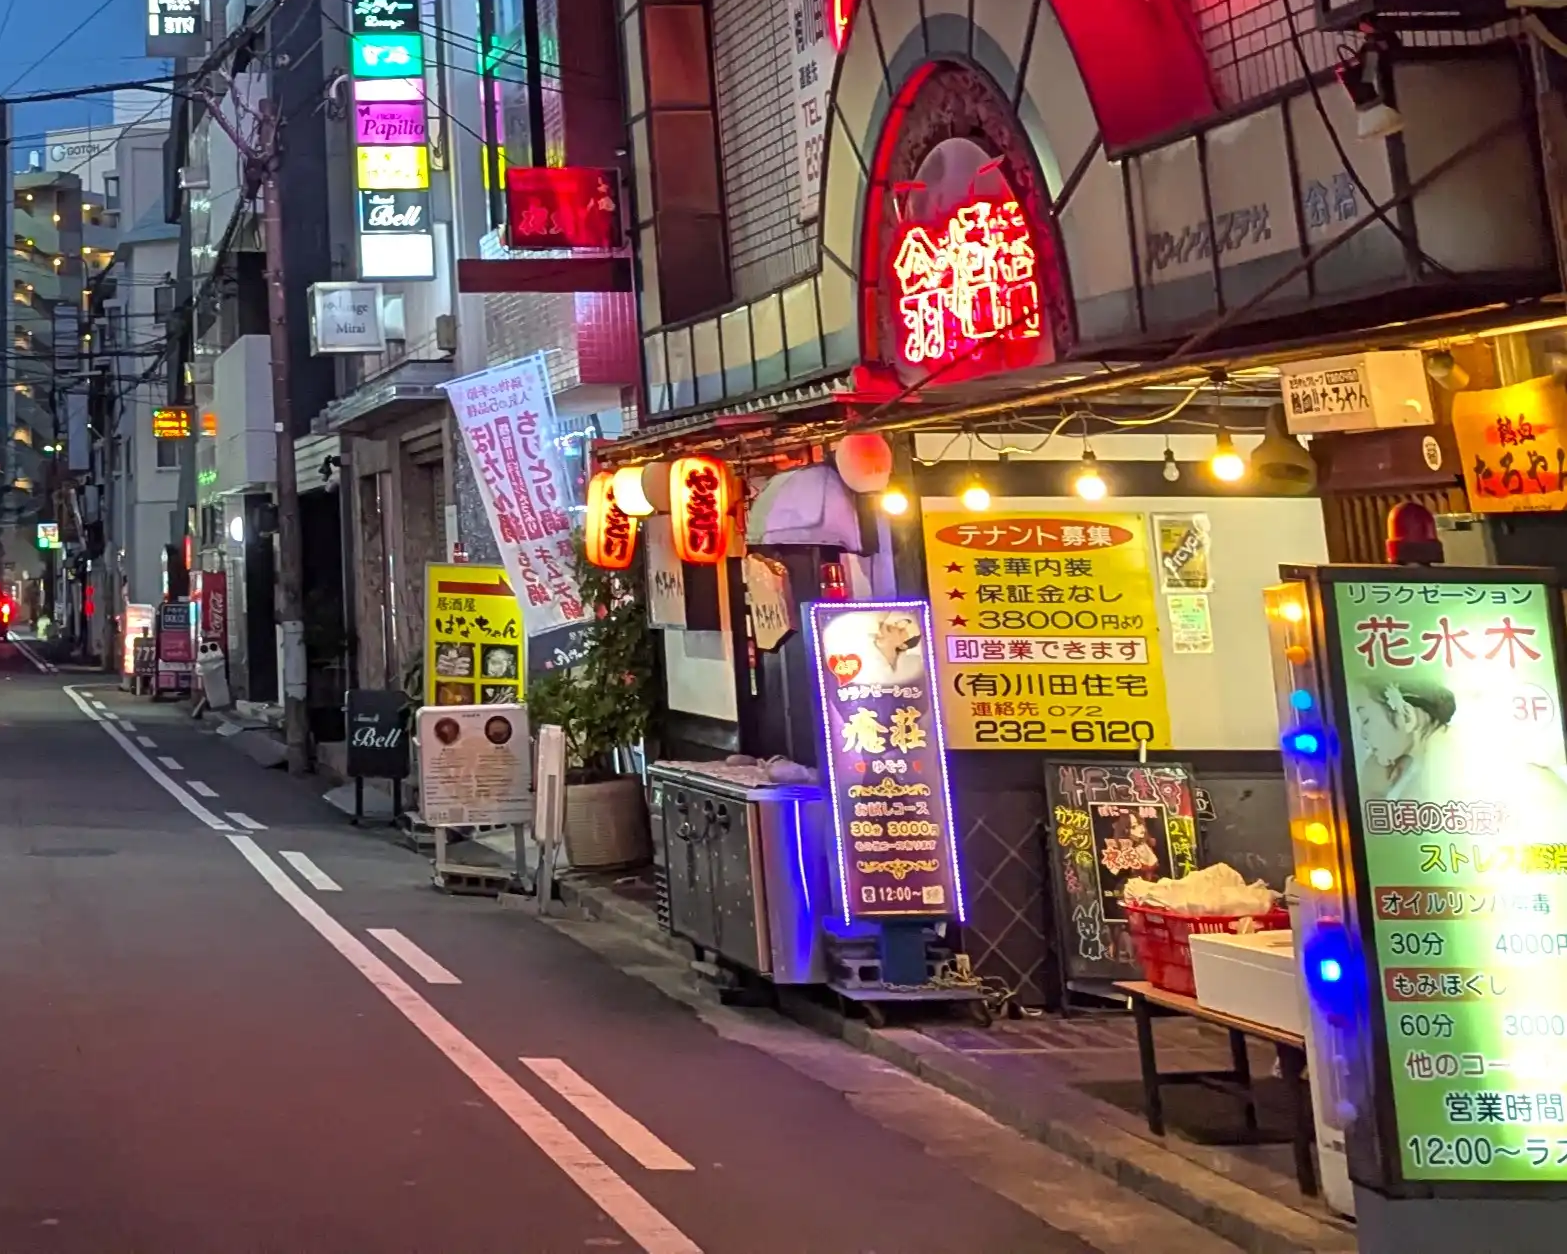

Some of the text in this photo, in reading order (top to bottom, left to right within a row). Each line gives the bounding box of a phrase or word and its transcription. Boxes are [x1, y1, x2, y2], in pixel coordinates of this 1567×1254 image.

[368, 204, 423, 228] Bell
[957, 524, 1114, 547] テナント募集
[973, 557, 1094, 578] 豪華内装
[437, 597, 477, 613] 居酒屋
[975, 584, 1124, 604] 保証金なし
[1348, 584, 1533, 605] リラクゼーション
[435, 615, 520, 639] はなちゃん
[978, 610, 1144, 631] 38000円より
[955, 639, 1142, 661] 即営業できます
[1356, 616, 1543, 669] 花水木
[952, 672, 1150, 698] (有)川田住宅
[970, 701, 1104, 718] 連絡先 072
[1512, 695, 1549, 723] 3F
[352, 726, 401, 749] Bell
[974, 720, 1155, 744] 232-6120
[1389, 932, 1445, 956] 30分
[1392, 974, 1507, 997] もみほぐし
[1399, 1014, 1455, 1038] 60分
[1444, 1093, 1565, 1124] 営業時間
